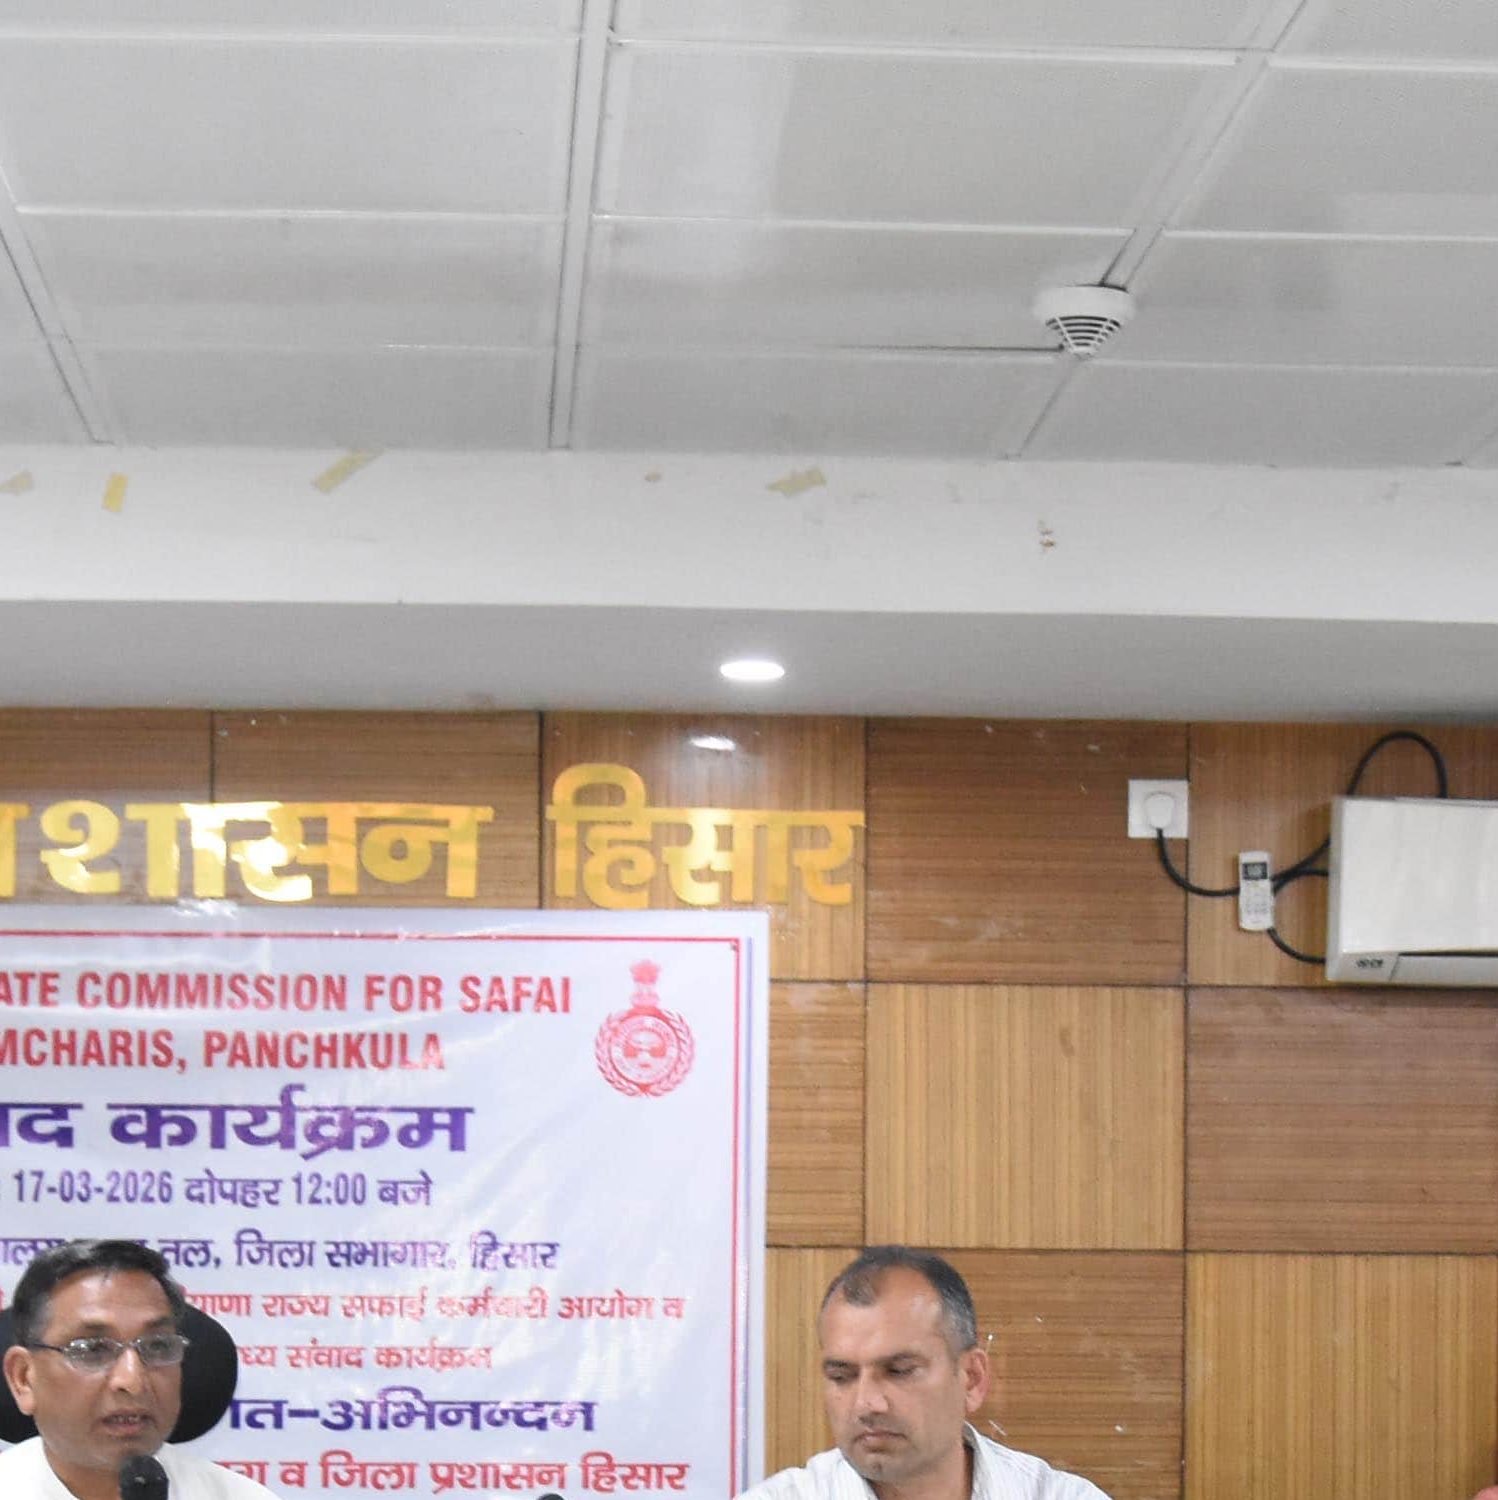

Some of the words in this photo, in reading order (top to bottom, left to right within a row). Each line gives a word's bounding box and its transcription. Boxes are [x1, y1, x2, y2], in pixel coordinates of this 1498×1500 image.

[545, 760, 867, 908] हिसार
[74, 969, 349, 1013] COMMISSION
[363, 973, 444, 1014] FOR
[458, 974, 572, 1015] SAFAI
[202, 1029, 445, 1071] PANCHKULA
[104, 1081, 476, 1163] कार्यक्रम
[11, 1168, 174, 1205] 17-03-2026
[183, 1167, 284, 1210] दोपहर
[291, 1171, 368, 1207] 12:00
[376, 1168, 434, 1207] बजे
[232, 1227, 316, 1270] जिला
[468, 1229, 561, 1272] हिसार
[261, 1294, 332, 1318] राज्य
[340, 1285, 428, 1322] सफाई
[556, 1288, 653, 1321] आयोग
[662, 1297, 685, 1319] व
[286, 1336, 366, 1370] संवाद
[373, 1336, 493, 1374] कार्यक्रम
[278, 1461, 309, 1489] व
[317, 1448, 420, 1492] जिला
[428, 1461, 569, 1498] प्रशासन
[578, 1450, 692, 1494] हिसार
